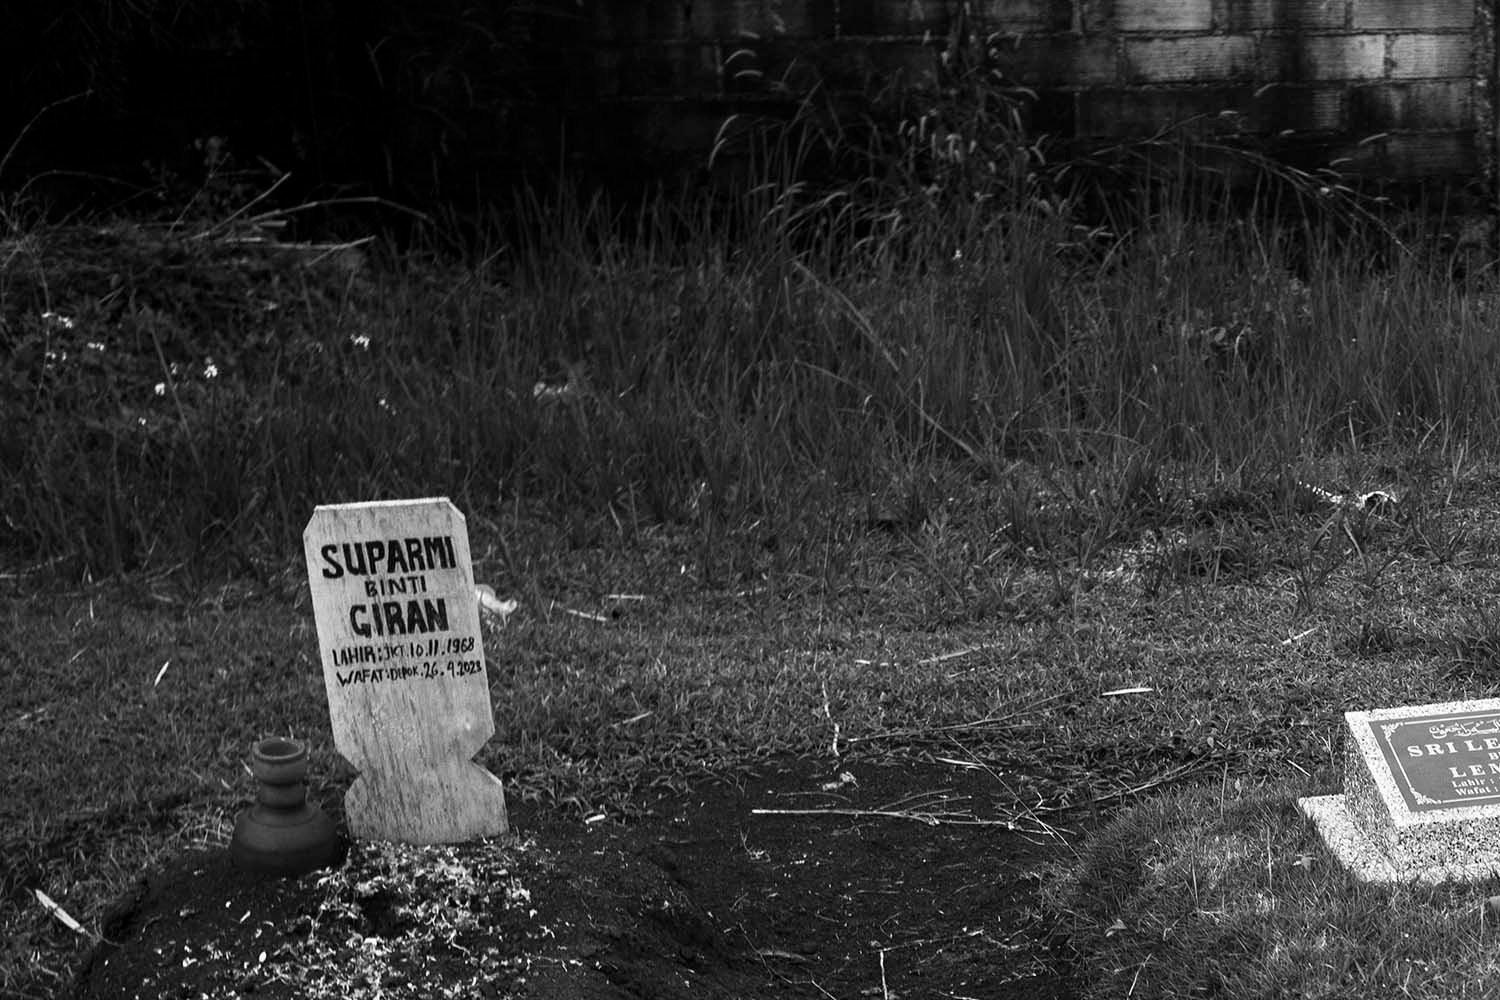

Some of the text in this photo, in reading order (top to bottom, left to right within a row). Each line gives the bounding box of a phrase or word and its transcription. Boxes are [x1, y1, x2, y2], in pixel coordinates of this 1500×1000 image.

[320, 535, 457, 579] SUPARMI
[364, 575, 428, 597] BINTI
[349, 598, 449, 639] GIRAN
[1407, 741, 1459, 759] SRI
[1451, 777, 1486, 788] Lahir
[1455, 784, 1491, 796] Wafat
